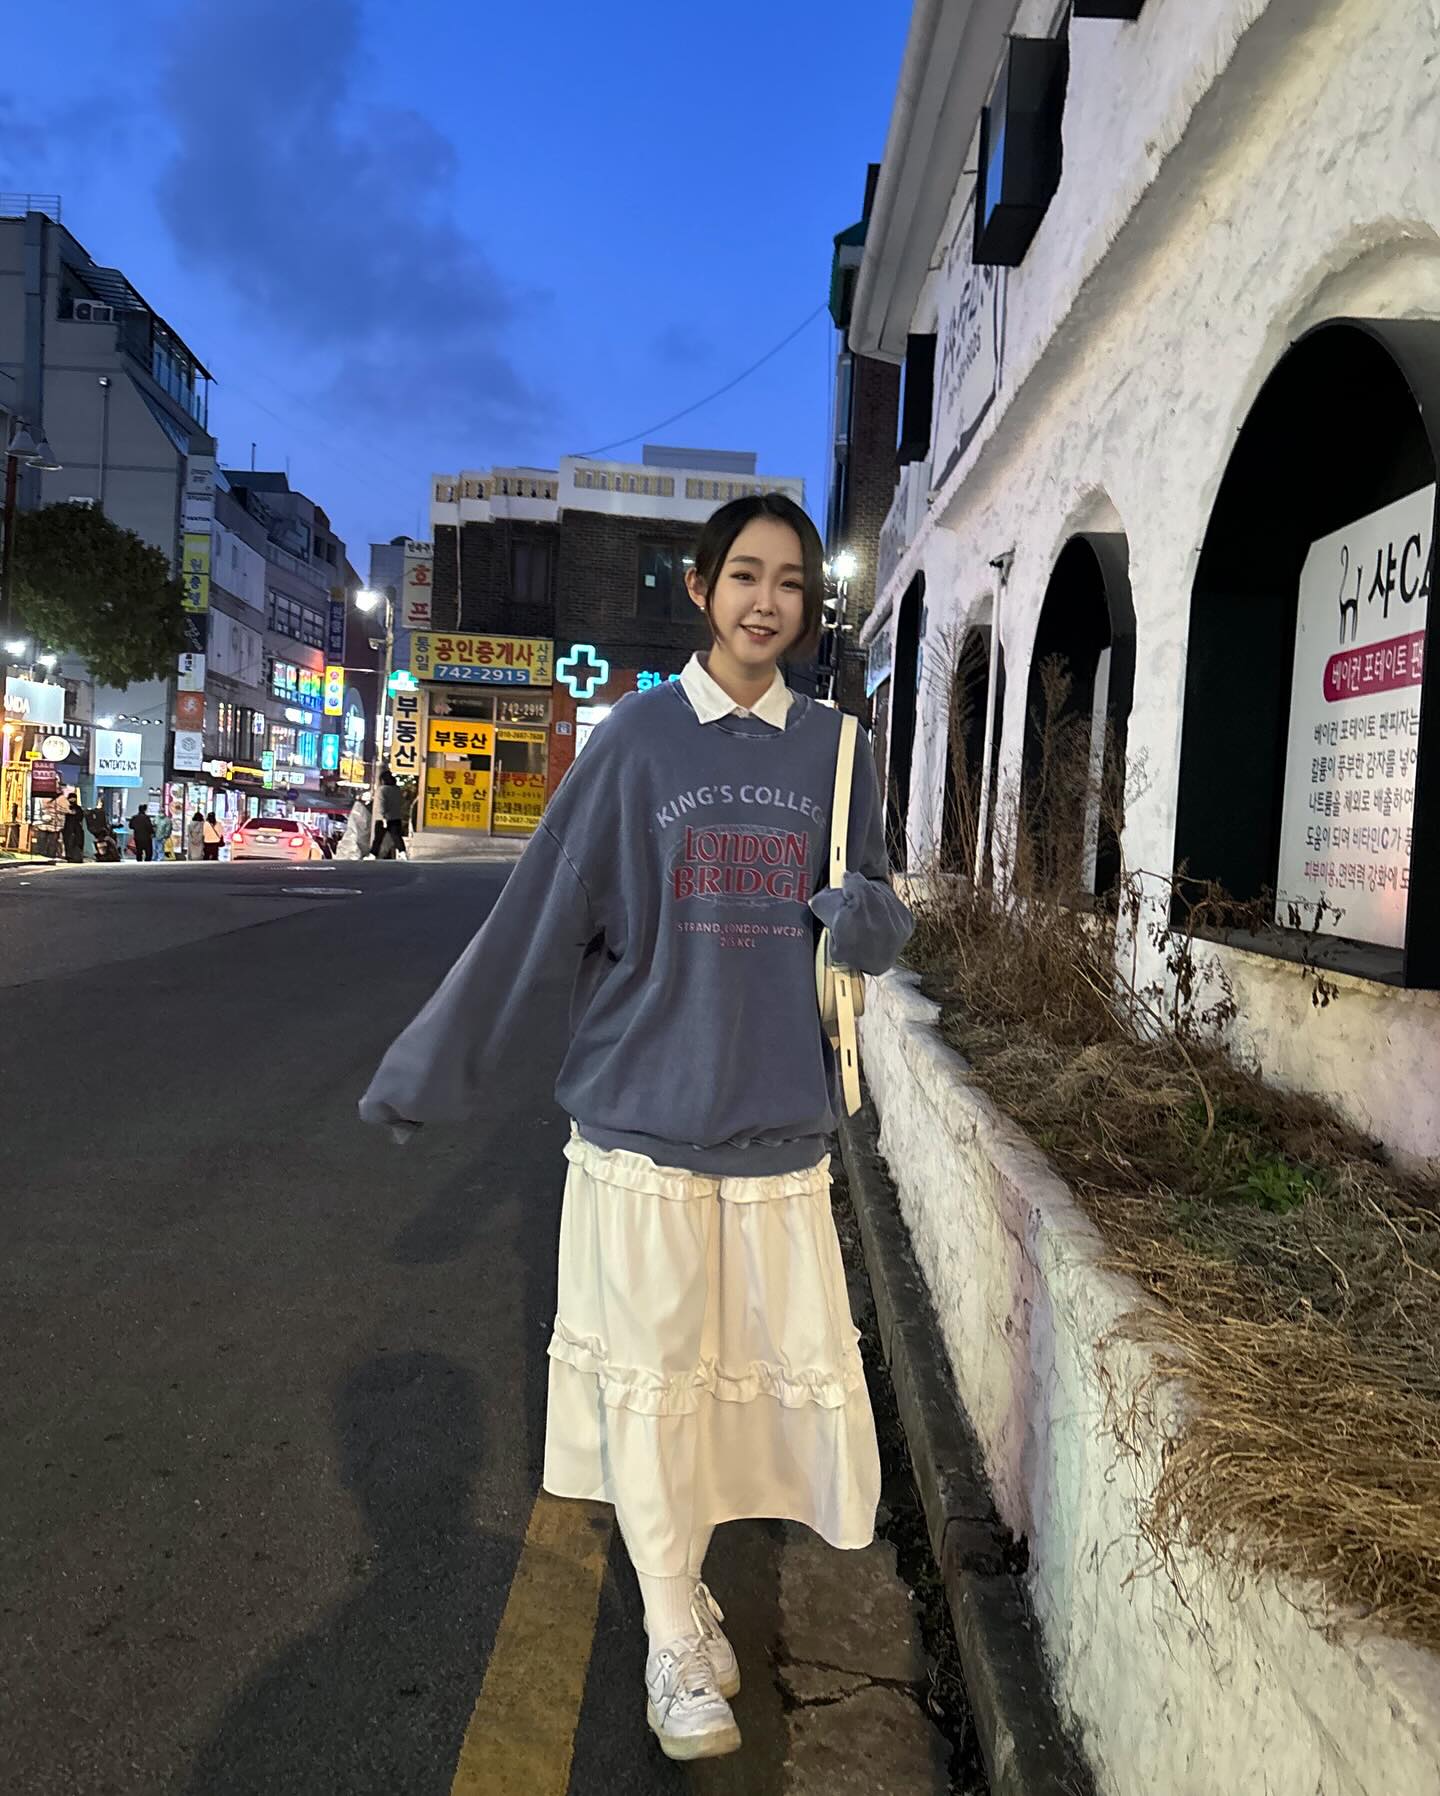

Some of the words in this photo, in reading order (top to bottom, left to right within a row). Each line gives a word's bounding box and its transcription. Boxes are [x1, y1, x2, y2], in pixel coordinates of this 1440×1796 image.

[416, 636, 430, 672] 통일
[435, 638, 534, 667] 공인중개사
[536, 643, 549, 676] 사무소
[1332, 654, 1362, 691] 베이컨
[1363, 644, 1407, 682] 포테이토
[438, 665, 526, 681] 742-2915
[395, 696, 418, 768] 부동산
[435, 731, 487, 749] 부동산
[1314, 721, 1338, 746] 베이컨
[1340, 715, 1375, 740] 포테이토
[1379, 708, 1419, 740] 팬피자는
[1338, 752, 1364, 782] 풍부한
[1366, 749, 1396, 779] 감자를
[656, 785, 734, 829] KING'S
[739, 785, 827, 828] COLLEG
[1309, 790, 1341, 817] 나트륨을
[1344, 788, 1371, 813] 체외로
[685, 825, 808, 866] LONDON
[1306, 825, 1330, 851] 도움이
[1366, 863, 1397, 892] 강화에
